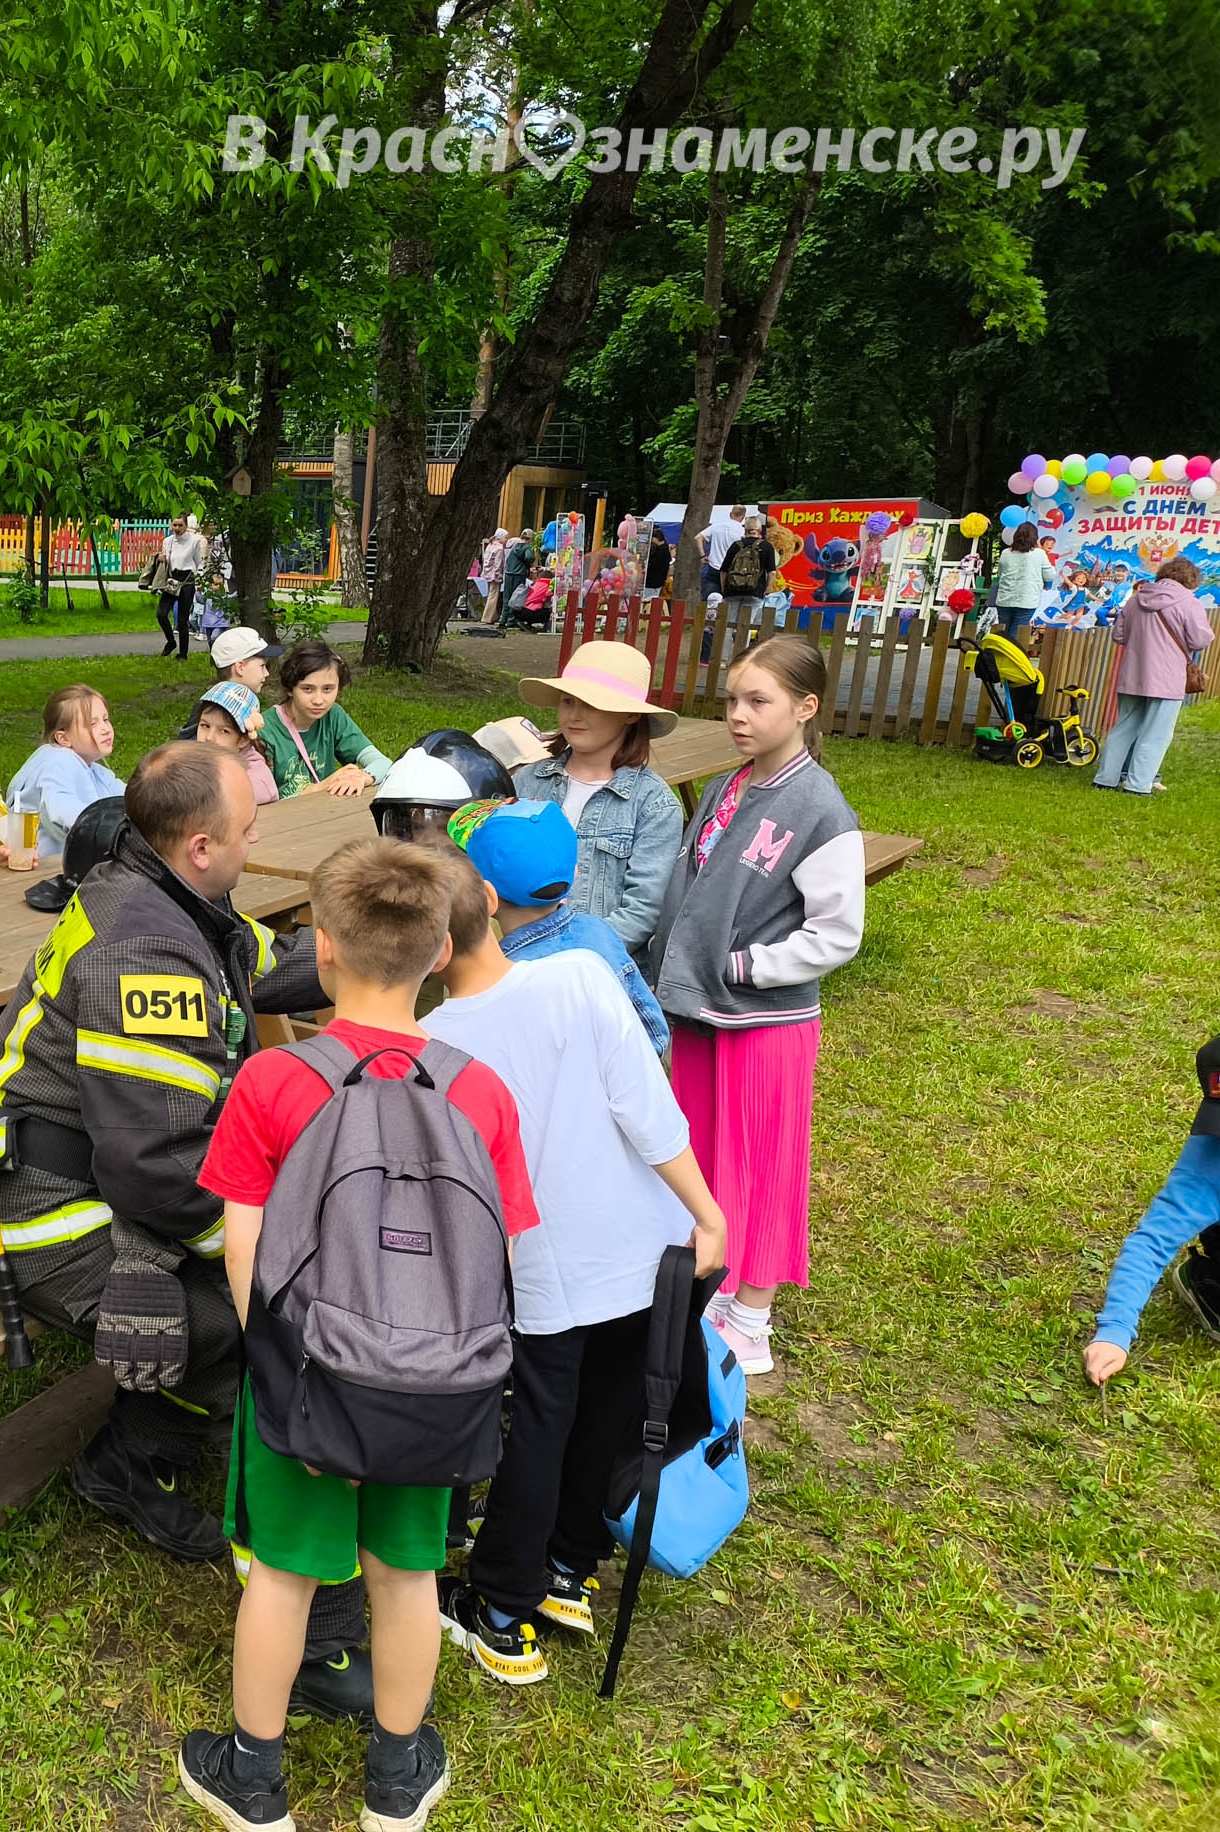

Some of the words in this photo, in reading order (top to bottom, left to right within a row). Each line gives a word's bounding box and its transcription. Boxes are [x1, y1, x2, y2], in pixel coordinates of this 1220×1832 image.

[1139, 486, 1145, 496] 1
[1122, 500, 1137, 515] С
[1142, 497, 1207, 516] ДНЁМ
[781, 508, 824, 526] Приз
[1077, 515, 1177, 534] ЗАЩИТЫ
[741, 817, 795, 873] M
[125, 990, 204, 1022] 0511
